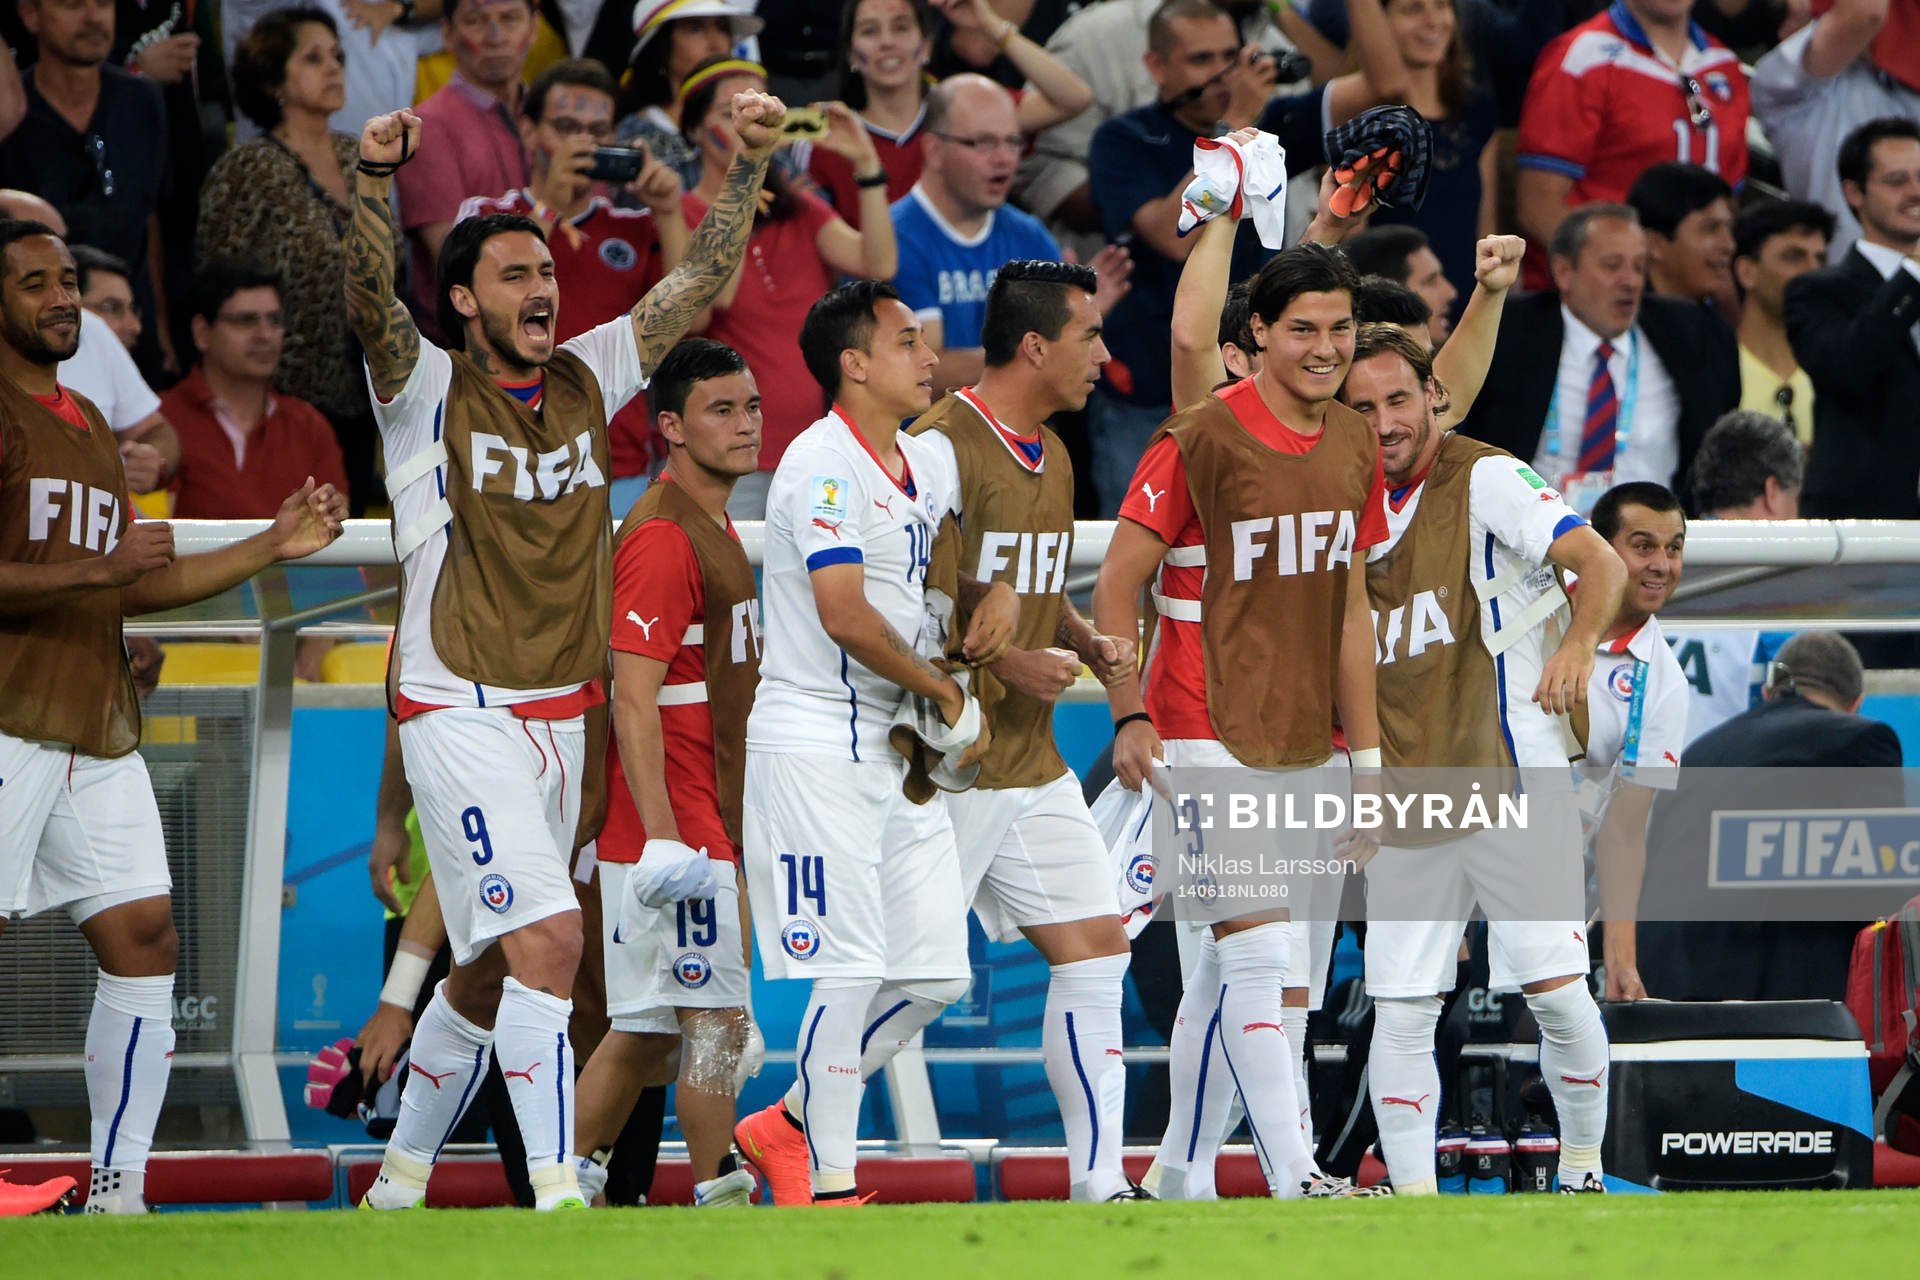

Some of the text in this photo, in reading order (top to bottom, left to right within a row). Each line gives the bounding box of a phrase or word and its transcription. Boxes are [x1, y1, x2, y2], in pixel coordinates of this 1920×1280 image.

[471, 430, 605, 501] FIFA
[1231, 510, 1356, 581] FIFA
[461, 806, 493, 866] 9
[780, 853, 826, 916] 14
[676, 896, 717, 948] 19
[1661, 1131, 1833, 1155] POWERADE
